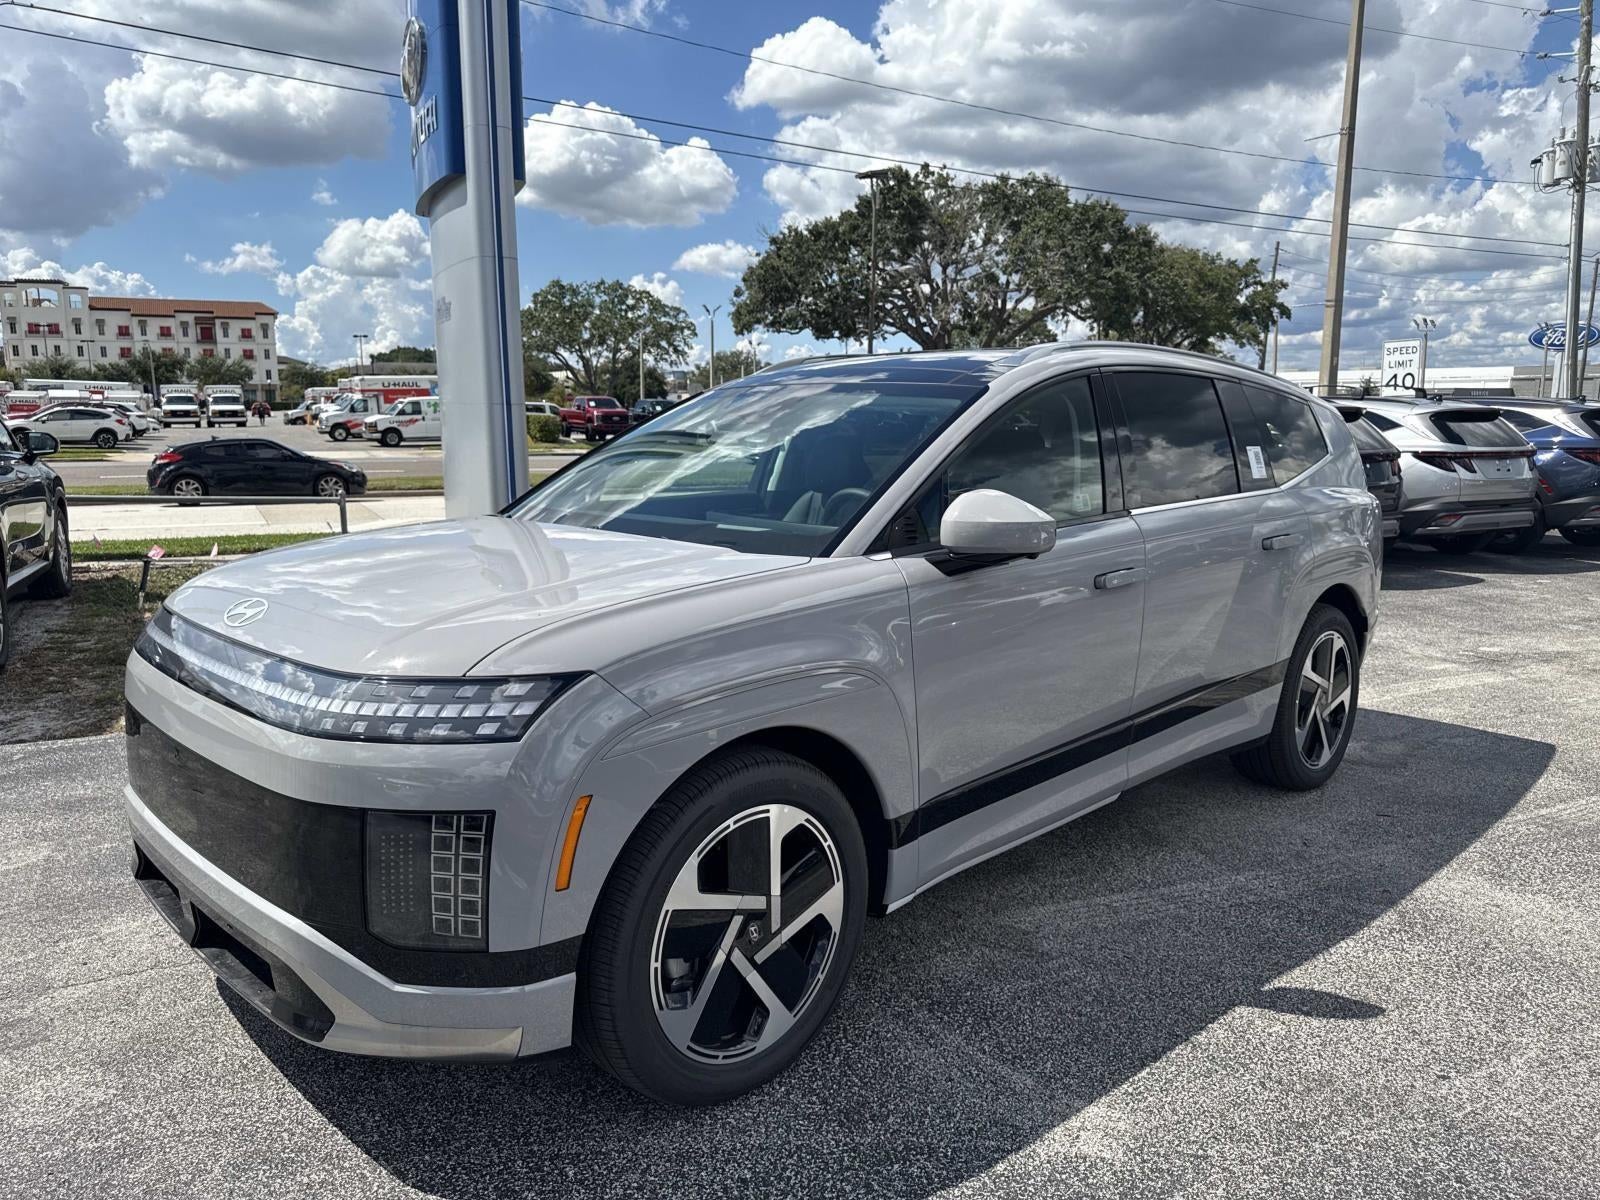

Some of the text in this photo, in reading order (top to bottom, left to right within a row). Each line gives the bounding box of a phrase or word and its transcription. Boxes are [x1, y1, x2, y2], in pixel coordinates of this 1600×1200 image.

[1542, 327, 1586, 345] Fod
[1386, 345, 1418, 356] SPEED
[1388, 359, 1413, 369] LIMIT
[1385, 372, 1416, 391] 40
